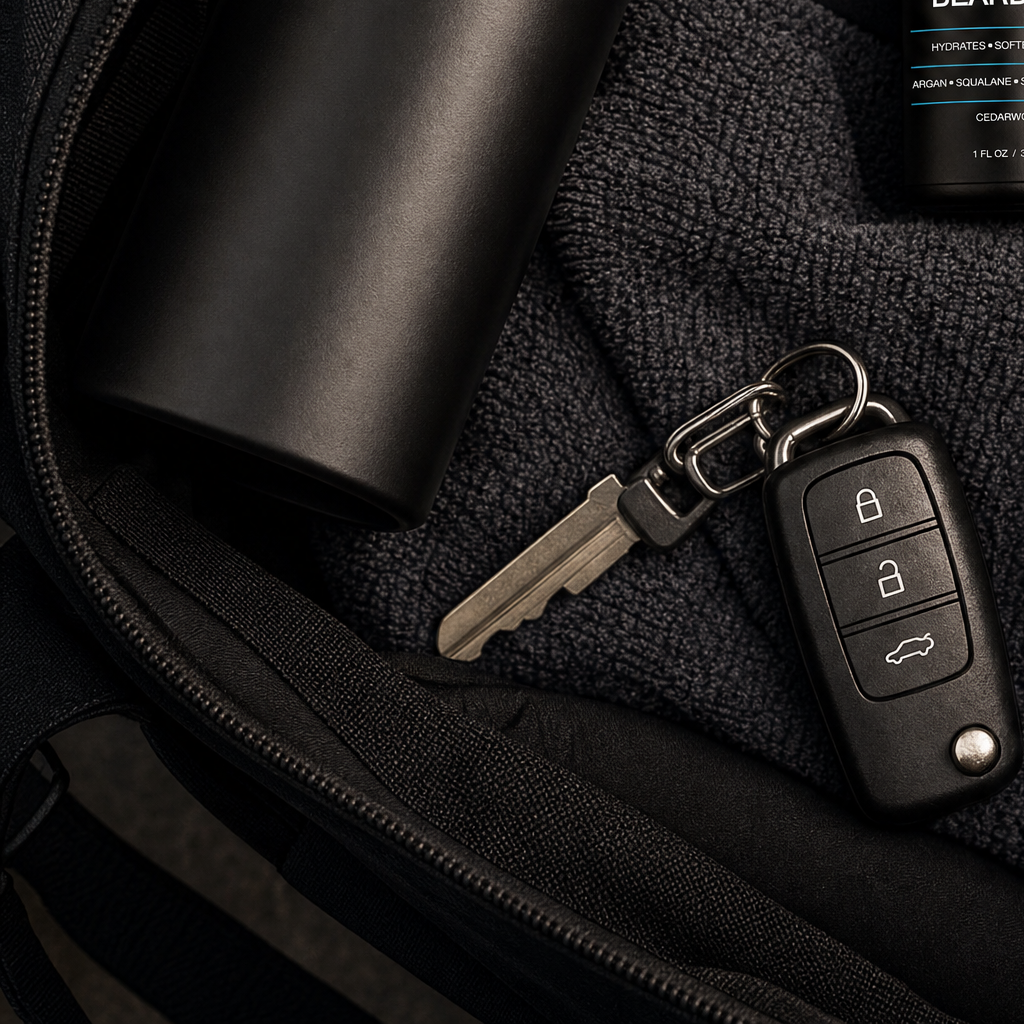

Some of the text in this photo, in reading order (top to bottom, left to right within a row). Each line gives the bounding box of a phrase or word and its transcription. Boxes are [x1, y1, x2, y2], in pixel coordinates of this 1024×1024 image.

[931, 41, 986, 51] HYDRATES
[912, 79, 947, 89] ARGAN
[956, 78, 1011, 87] SQUALANE
[973, 150, 977, 158] 1
[981, 150, 992, 158] FL
